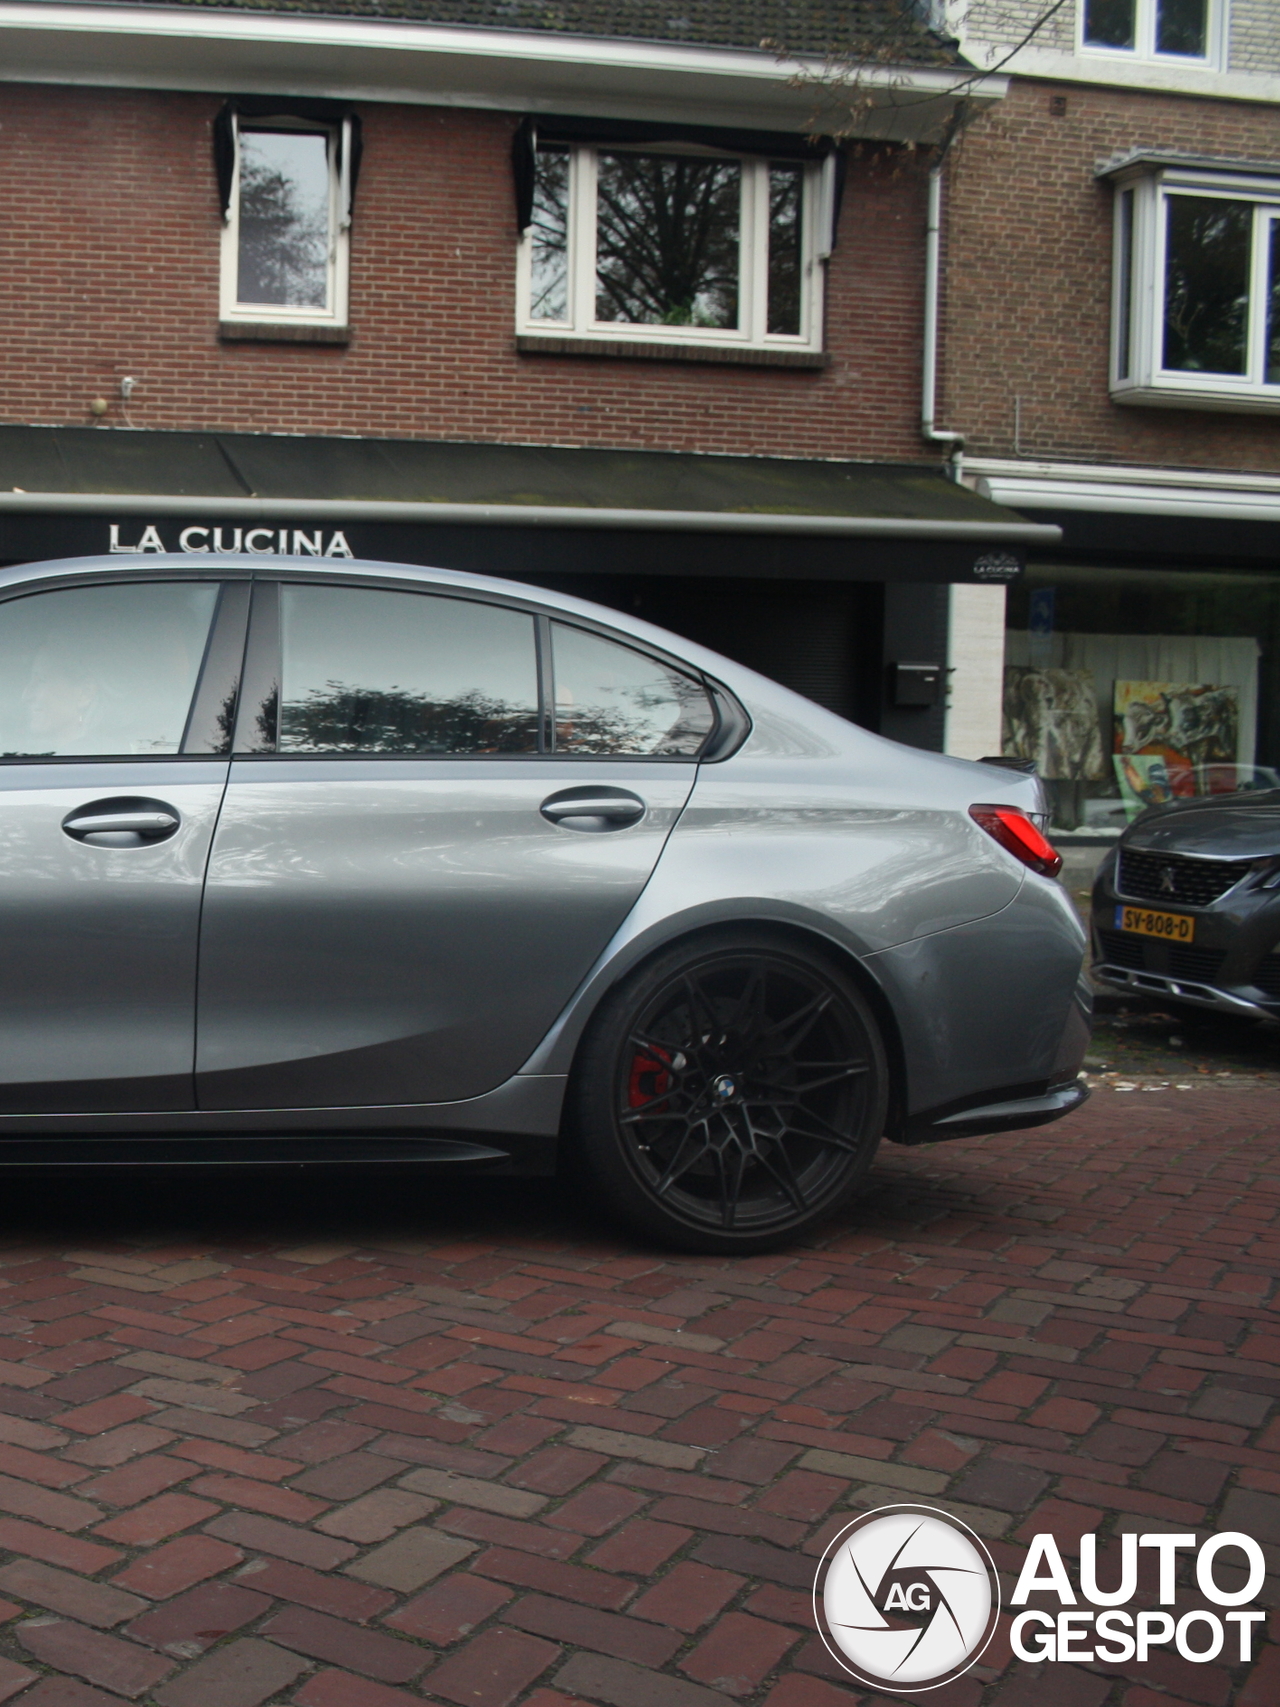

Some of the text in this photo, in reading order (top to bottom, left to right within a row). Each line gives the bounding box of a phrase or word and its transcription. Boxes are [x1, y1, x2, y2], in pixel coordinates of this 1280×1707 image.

[109, 524, 354, 559] LA CUCINA
[1125, 910, 1189, 938] SV-808-D
